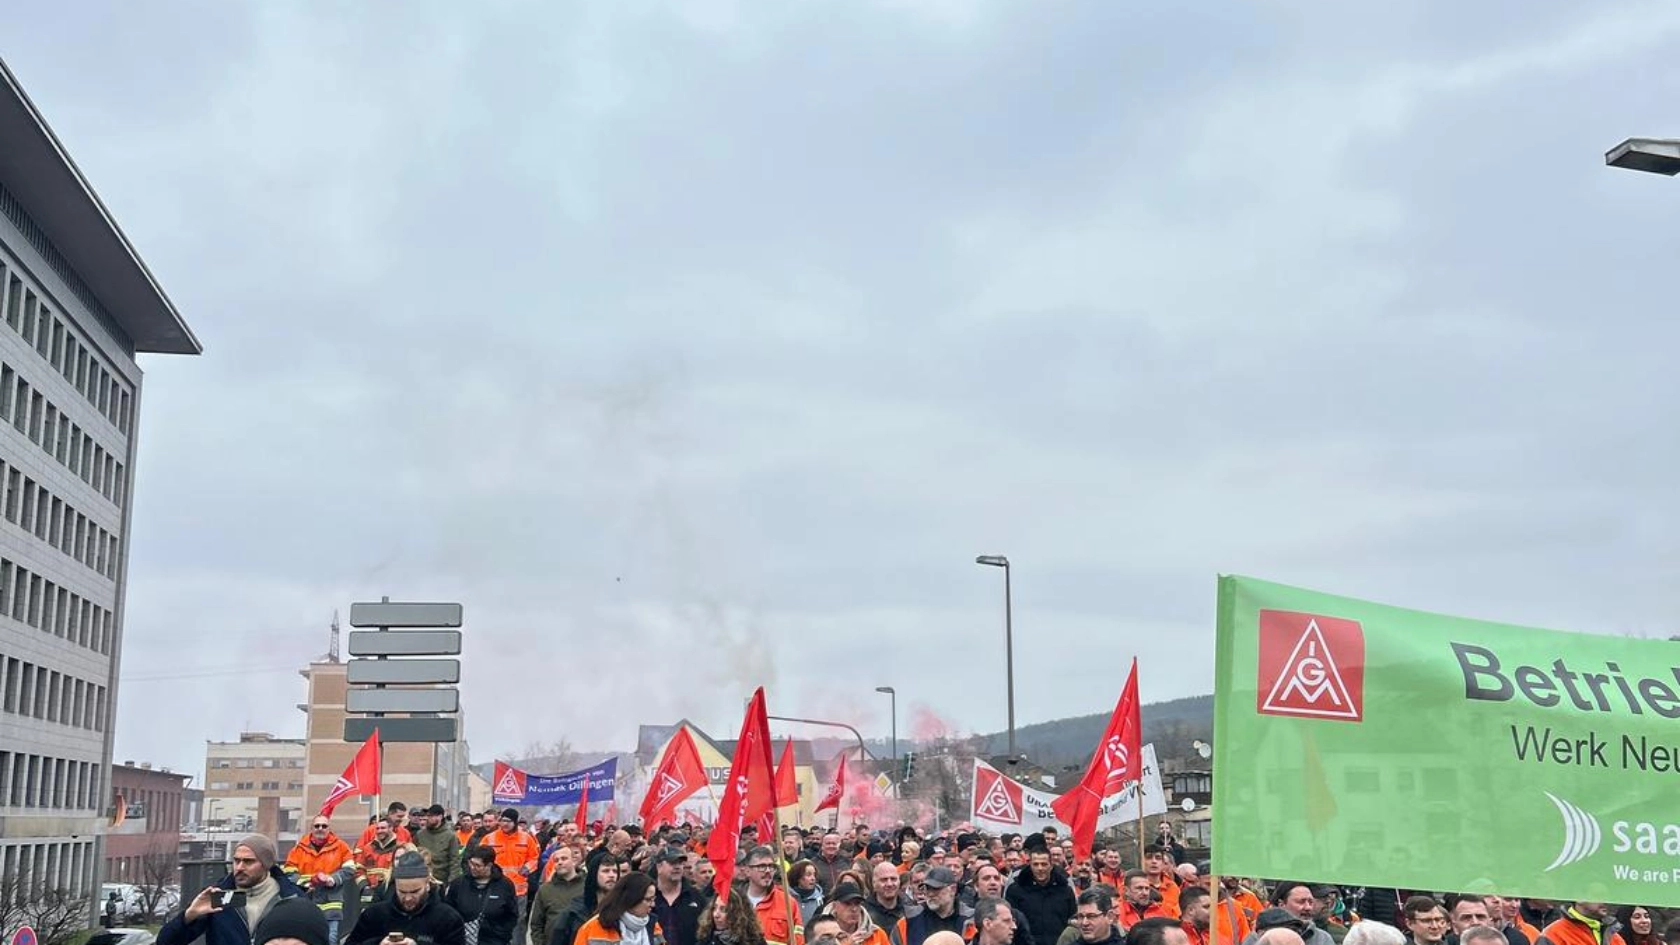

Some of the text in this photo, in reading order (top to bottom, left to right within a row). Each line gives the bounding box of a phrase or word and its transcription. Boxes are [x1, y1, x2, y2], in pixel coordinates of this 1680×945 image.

[1280, 641, 1341, 705] IGM
[1450, 642, 1680, 718] Betrie
[1511, 725, 1608, 767] Werk
[1613, 865, 1639, 881] We
[1643, 869, 1669, 883] are
